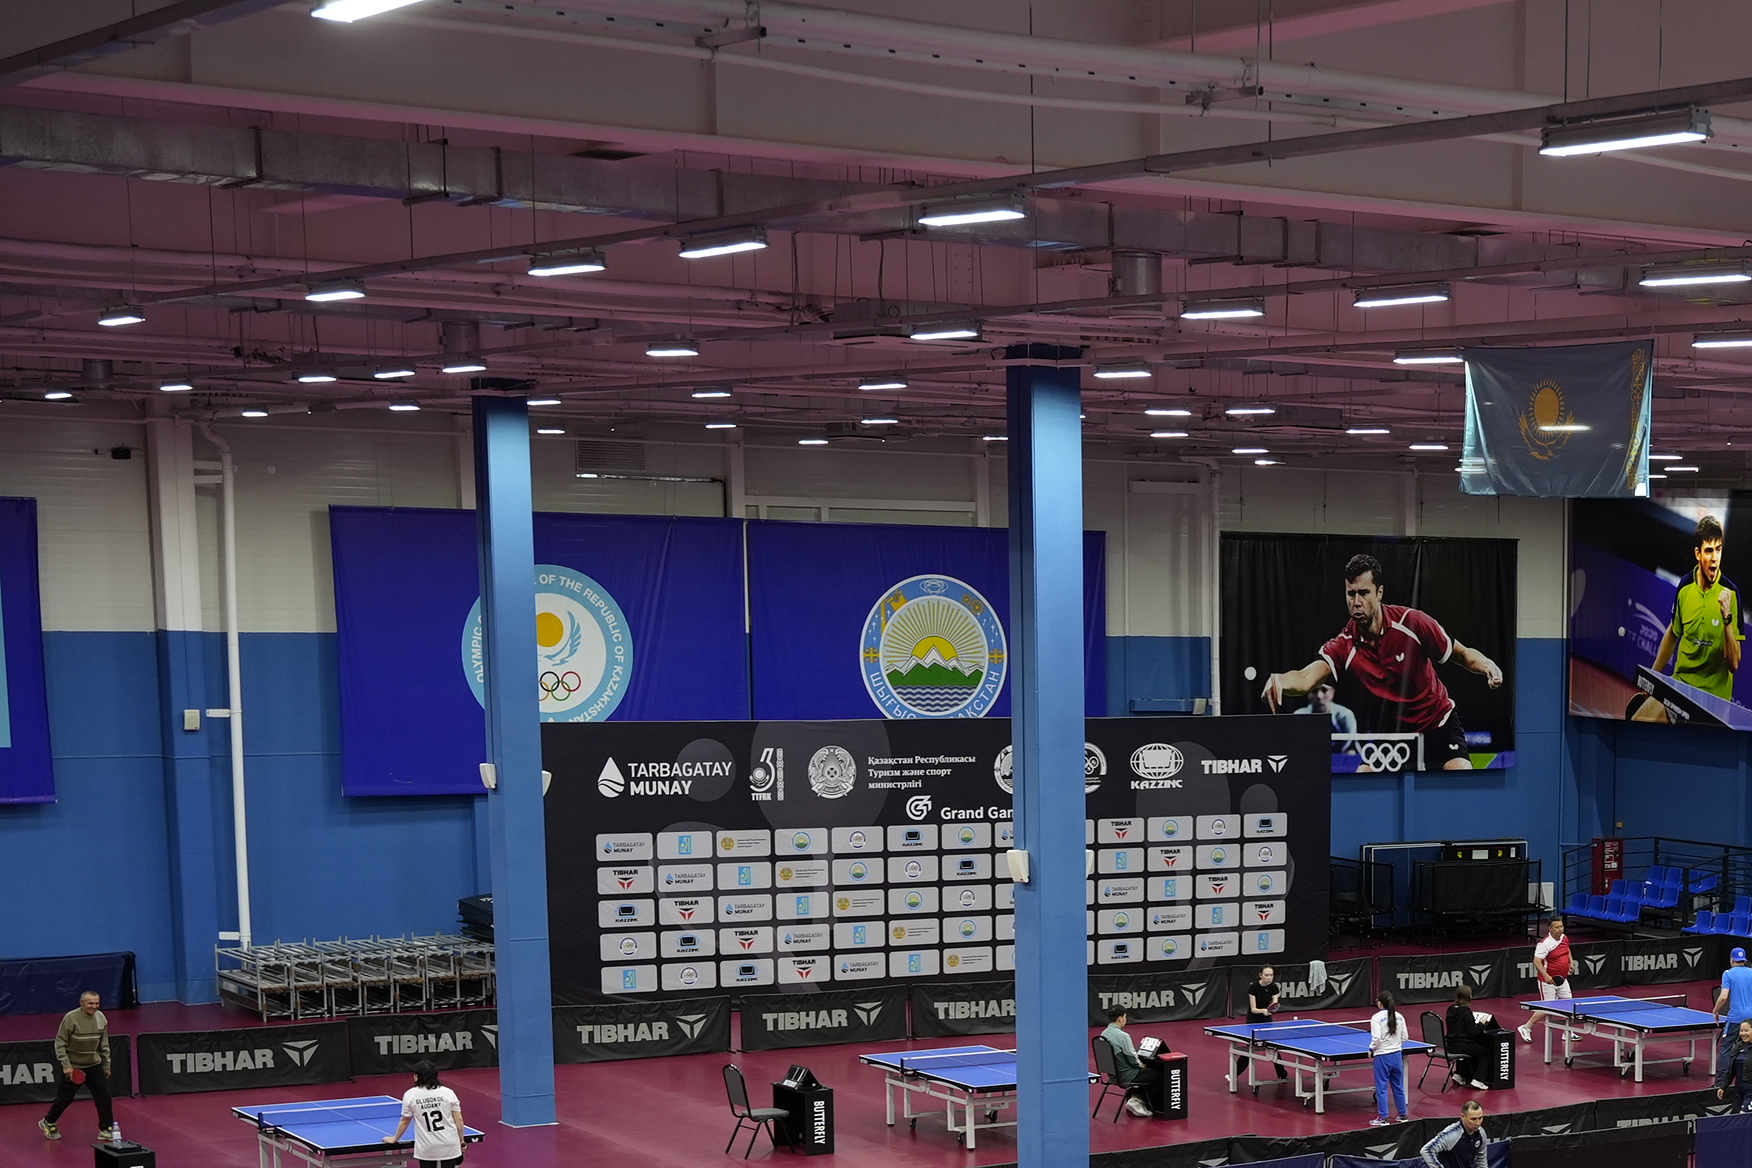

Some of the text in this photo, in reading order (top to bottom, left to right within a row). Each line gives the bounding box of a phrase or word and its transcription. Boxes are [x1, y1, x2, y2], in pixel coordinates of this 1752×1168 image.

[539, 574, 556, 585] OF
[559, 576, 583, 593] THE
[583, 588, 623, 643] REPUBLIC
[614, 645, 625, 663] OF
[628, 761, 732, 778] TARBAGATAY
[868, 755, 976, 765] Қазақстан Республикасы
[1201, 759, 1262, 774] TIBHAR
[868, 767, 952, 778] Туризм және спорт
[630, 780, 692, 796] MUNAY
[868, 779, 922, 789] министрлігі
[1131, 779, 1183, 790] KAZZINC
[751, 792, 772, 801] TTFRK
[940, 806, 984, 820] Grand
[1397, 970, 1463, 990] TIBHAR
[933, 1000, 1016, 1020] TIBHAR
[1099, 991, 1176, 1010] TIBHAR
[762, 1009, 848, 1031] TIBHAR
[577, 1021, 669, 1044] TIBHAR
[374, 1031, 474, 1055] TIBHAR
[167, 1048, 275, 1075] TIBHAR
[1500, 1042, 1509, 1080] BUTTERFLY
[0, 1062, 55, 1085] HAR
[1171, 1069, 1181, 1110] BUTTERFLY
[422, 1110, 445, 1132] 12
[813, 1101, 826, 1145] BUTTERFLY
